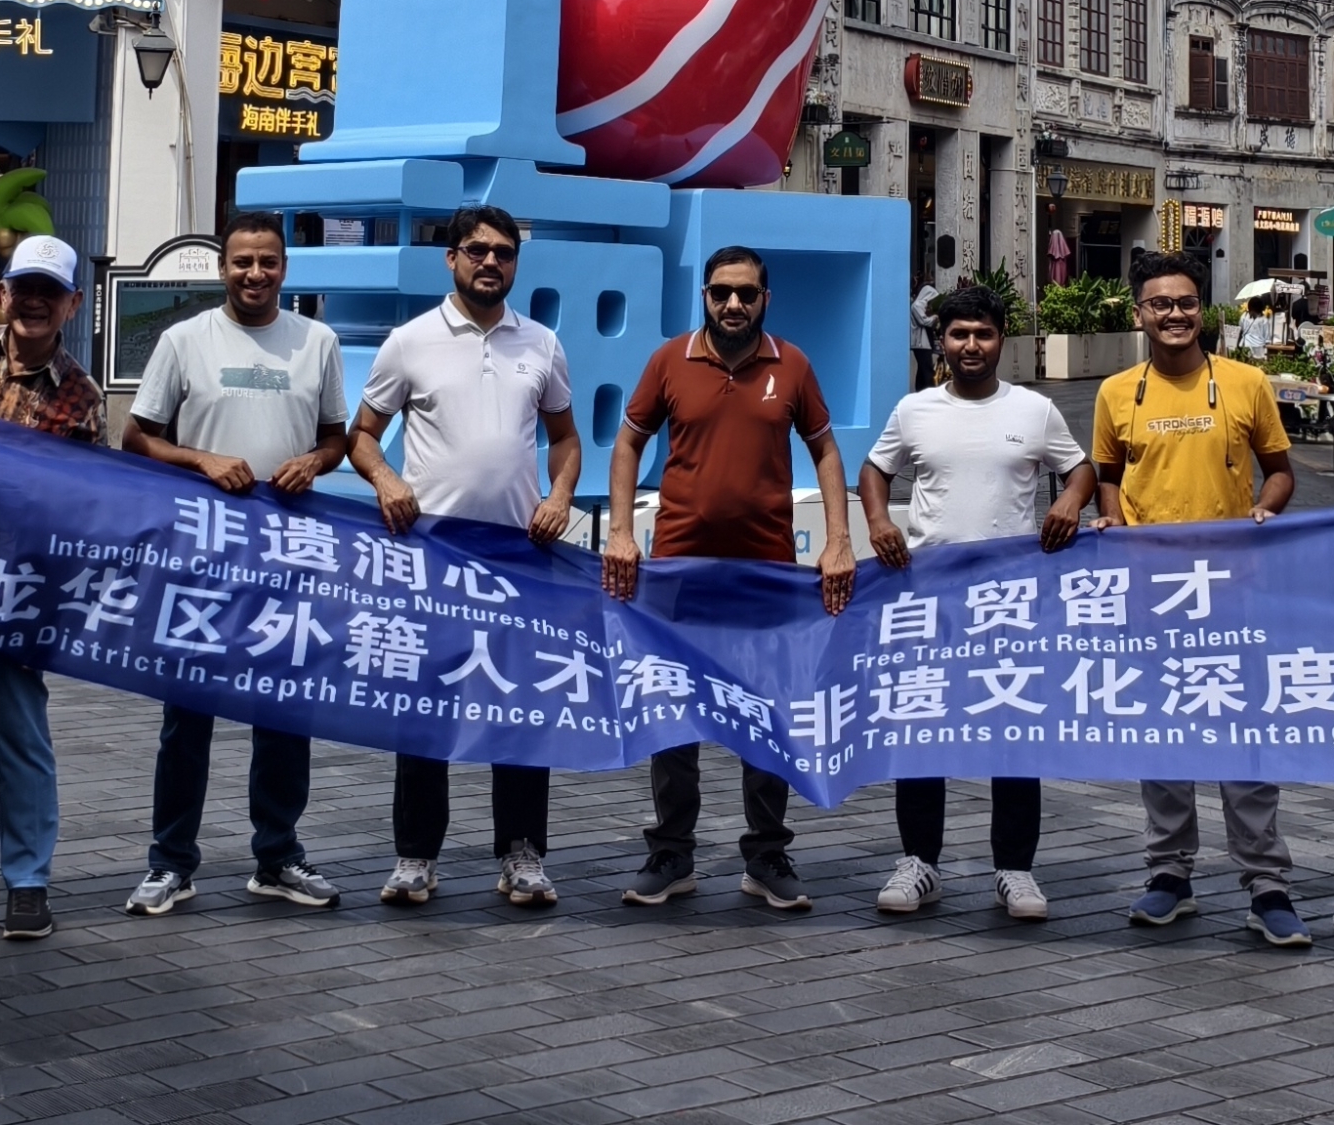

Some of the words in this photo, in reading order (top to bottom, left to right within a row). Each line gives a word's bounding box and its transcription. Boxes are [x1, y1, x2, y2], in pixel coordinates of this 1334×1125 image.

[241, 103, 321, 136] 海南伴手礼
[1147, 415, 1213, 431] STRONGER
[48, 534, 183, 573] Intangible
[188, 555, 292, 591] Cultural
[298, 572, 408, 612] Heritage
[413, 594, 528, 629] Nurtures
[530, 616, 570, 642] the
[574, 628, 624, 659] Soul
[173, 496, 520, 604] 非遗润心
[878, 559, 1231, 644] 自贸留才
[853, 649, 906, 672] Free
[912, 641, 987, 663] Trade
[993, 635, 1049, 655] Port
[1056, 629, 1157, 653] Retains
[1163, 625, 1268, 649] Talents
[35, 624, 166, 676] District
[177, 657, 338, 705] In-depth
[348, 680, 545, 728] Experience
[556, 702, 686, 738] Activity
[696, 701, 741, 731] for
[748, 726, 855, 776] Foreign
[865, 724, 992, 750] Talents
[1004, 722, 1046, 743] on
[1058, 720, 1218, 745] Hainan's
